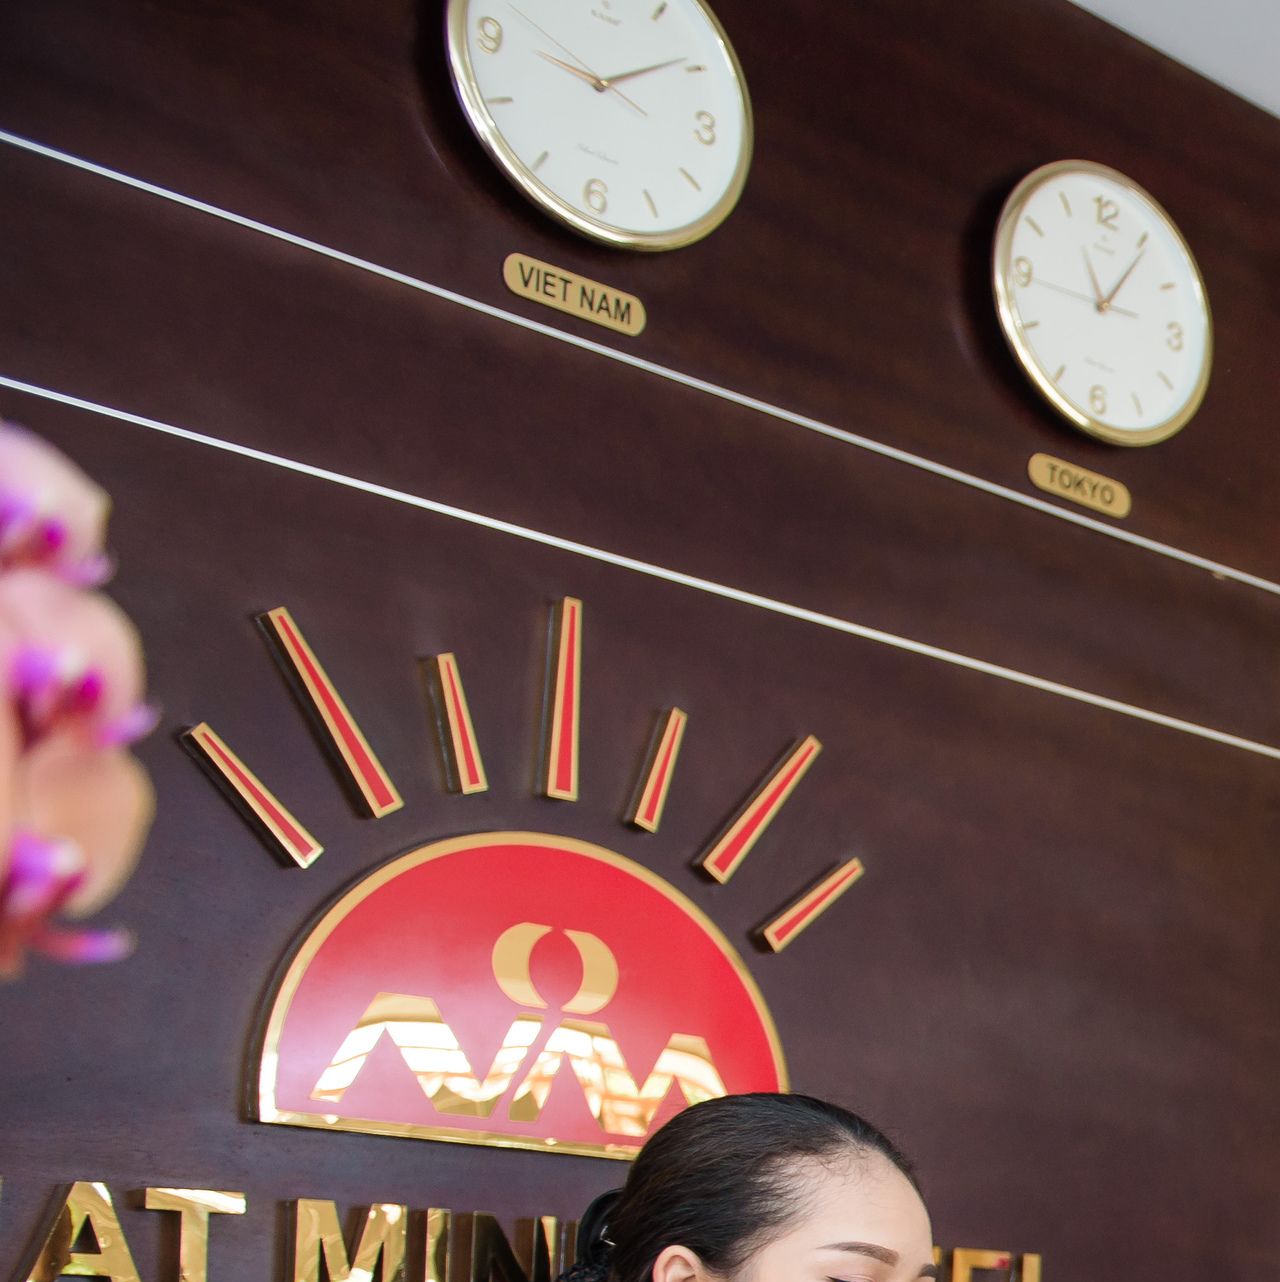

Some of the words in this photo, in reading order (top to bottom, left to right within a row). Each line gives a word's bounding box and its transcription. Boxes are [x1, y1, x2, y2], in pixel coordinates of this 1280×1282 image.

[478, 16, 502, 54] 9
[694, 110, 716, 146] 3
[583, 178, 608, 215] 6
[1093, 195, 1120, 232] 12
[1014, 256, 1033, 288] 9
[518, 261, 572, 302] VIET
[580, 285, 631, 325] NAM
[1166, 322, 1184, 352] 3
[1089, 385, 1107, 416] 6
[1047, 462, 1115, 507] TOKYO
